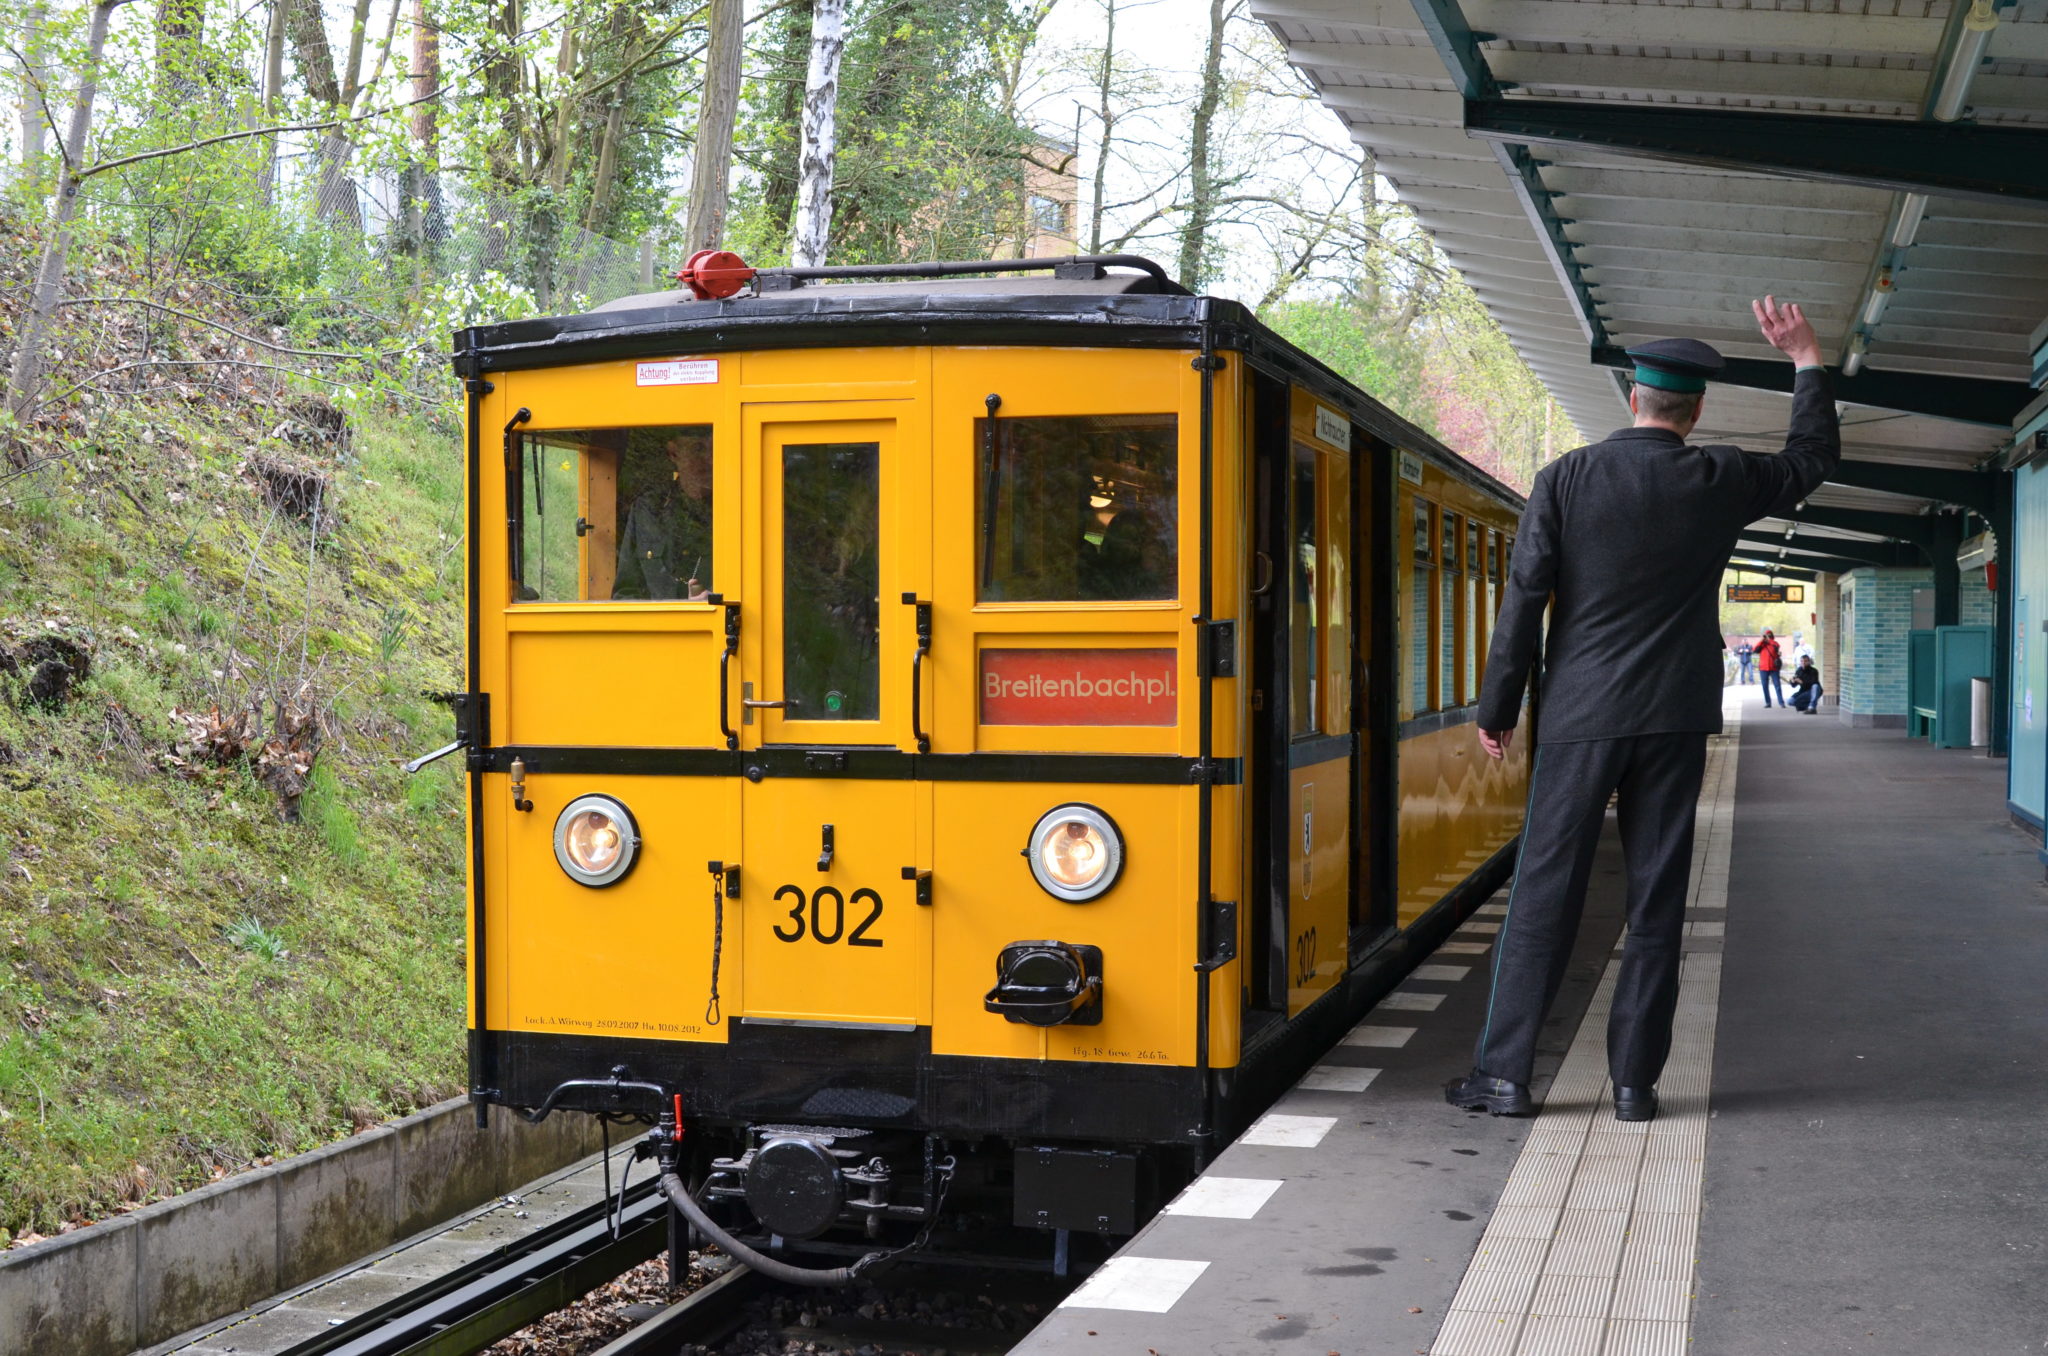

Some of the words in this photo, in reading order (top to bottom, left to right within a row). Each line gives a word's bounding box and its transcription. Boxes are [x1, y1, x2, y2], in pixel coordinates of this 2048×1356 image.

[639, 367, 671, 380] Achtung!
[985, 671, 1176, 704] Breitenbachpl.
[773, 884, 883, 947] 302
[1296, 925, 1316, 989] 302
